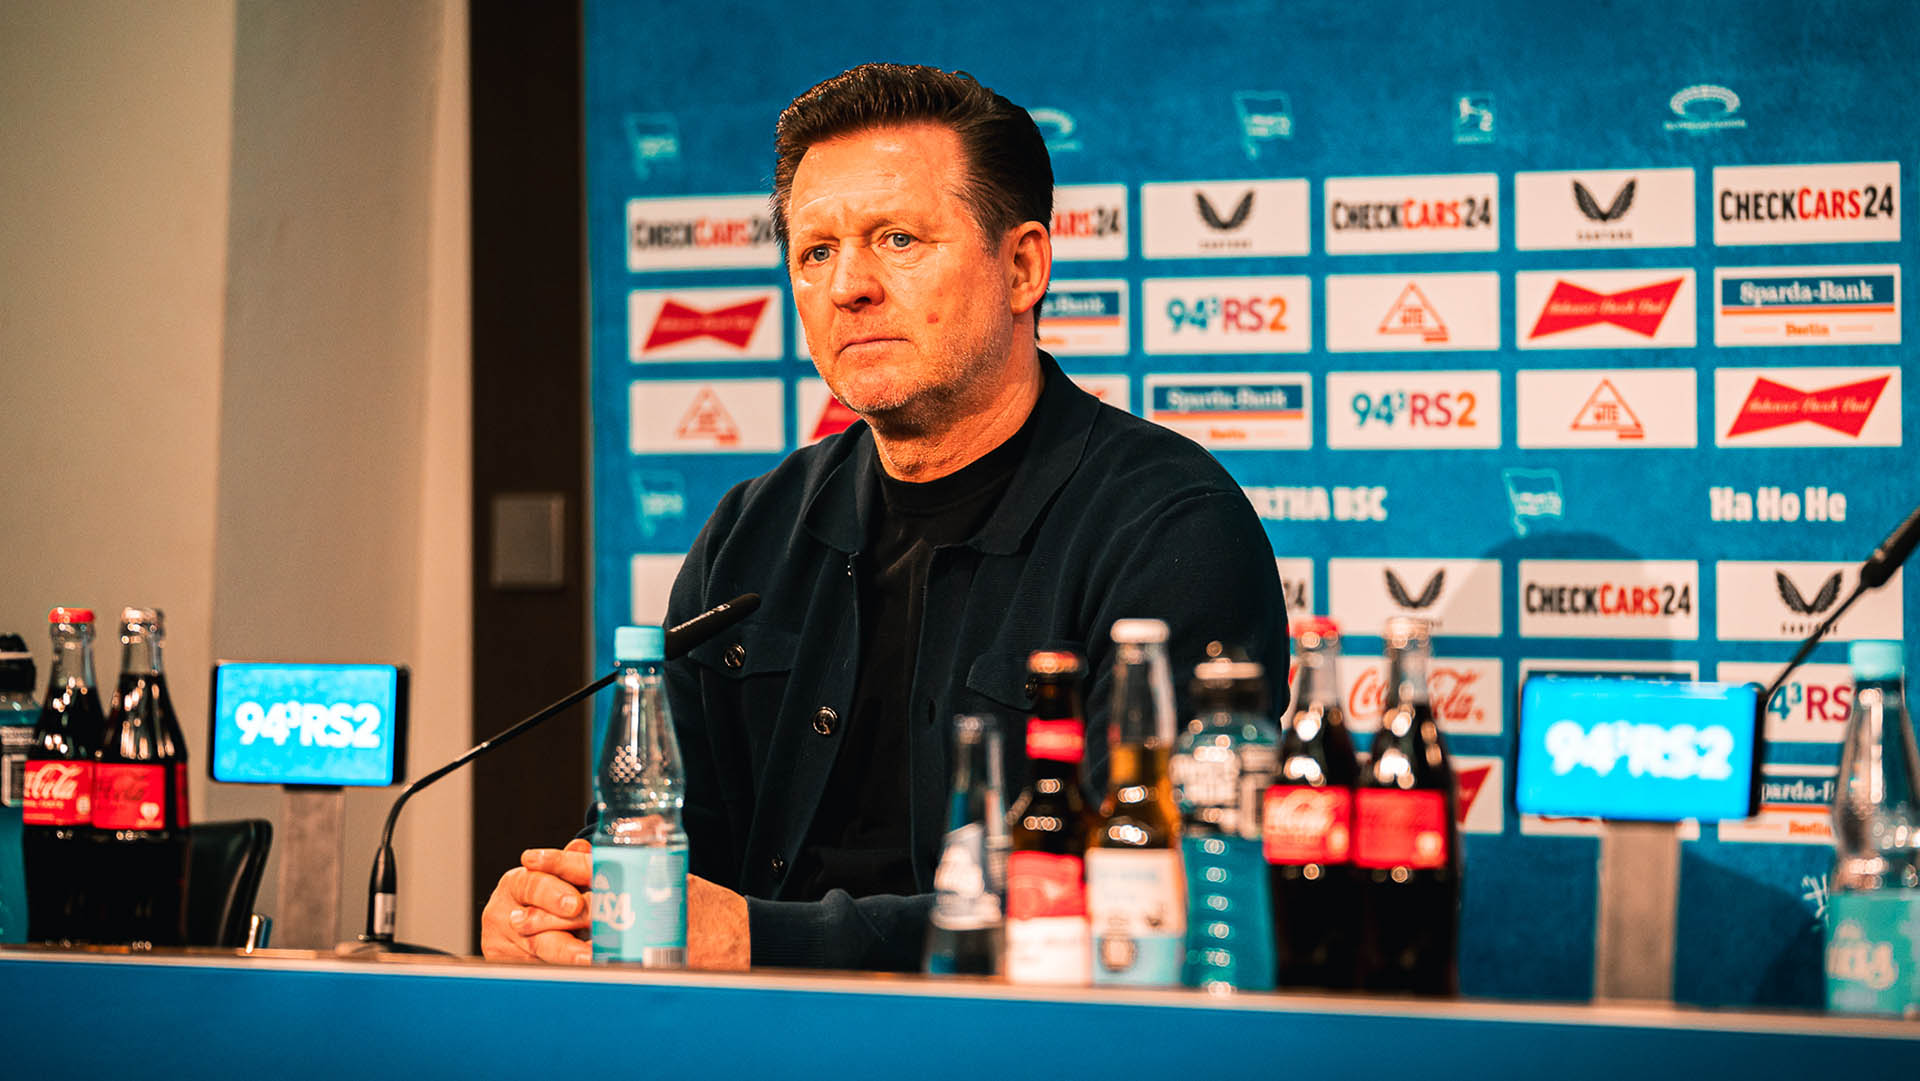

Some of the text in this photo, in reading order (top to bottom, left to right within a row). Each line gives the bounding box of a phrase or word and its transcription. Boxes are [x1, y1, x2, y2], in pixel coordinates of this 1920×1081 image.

[1332, 195, 1491, 231] CHECKCARS24
[1719, 184, 1894, 222] CHECKCARS24
[1739, 280, 1874, 307] Sparda-Bank
[1709, 486, 1848, 522] Ha Ho He
[1525, 583, 1692, 616] CHECKCARS24
[1768, 682, 1856, 722] 4³RS
